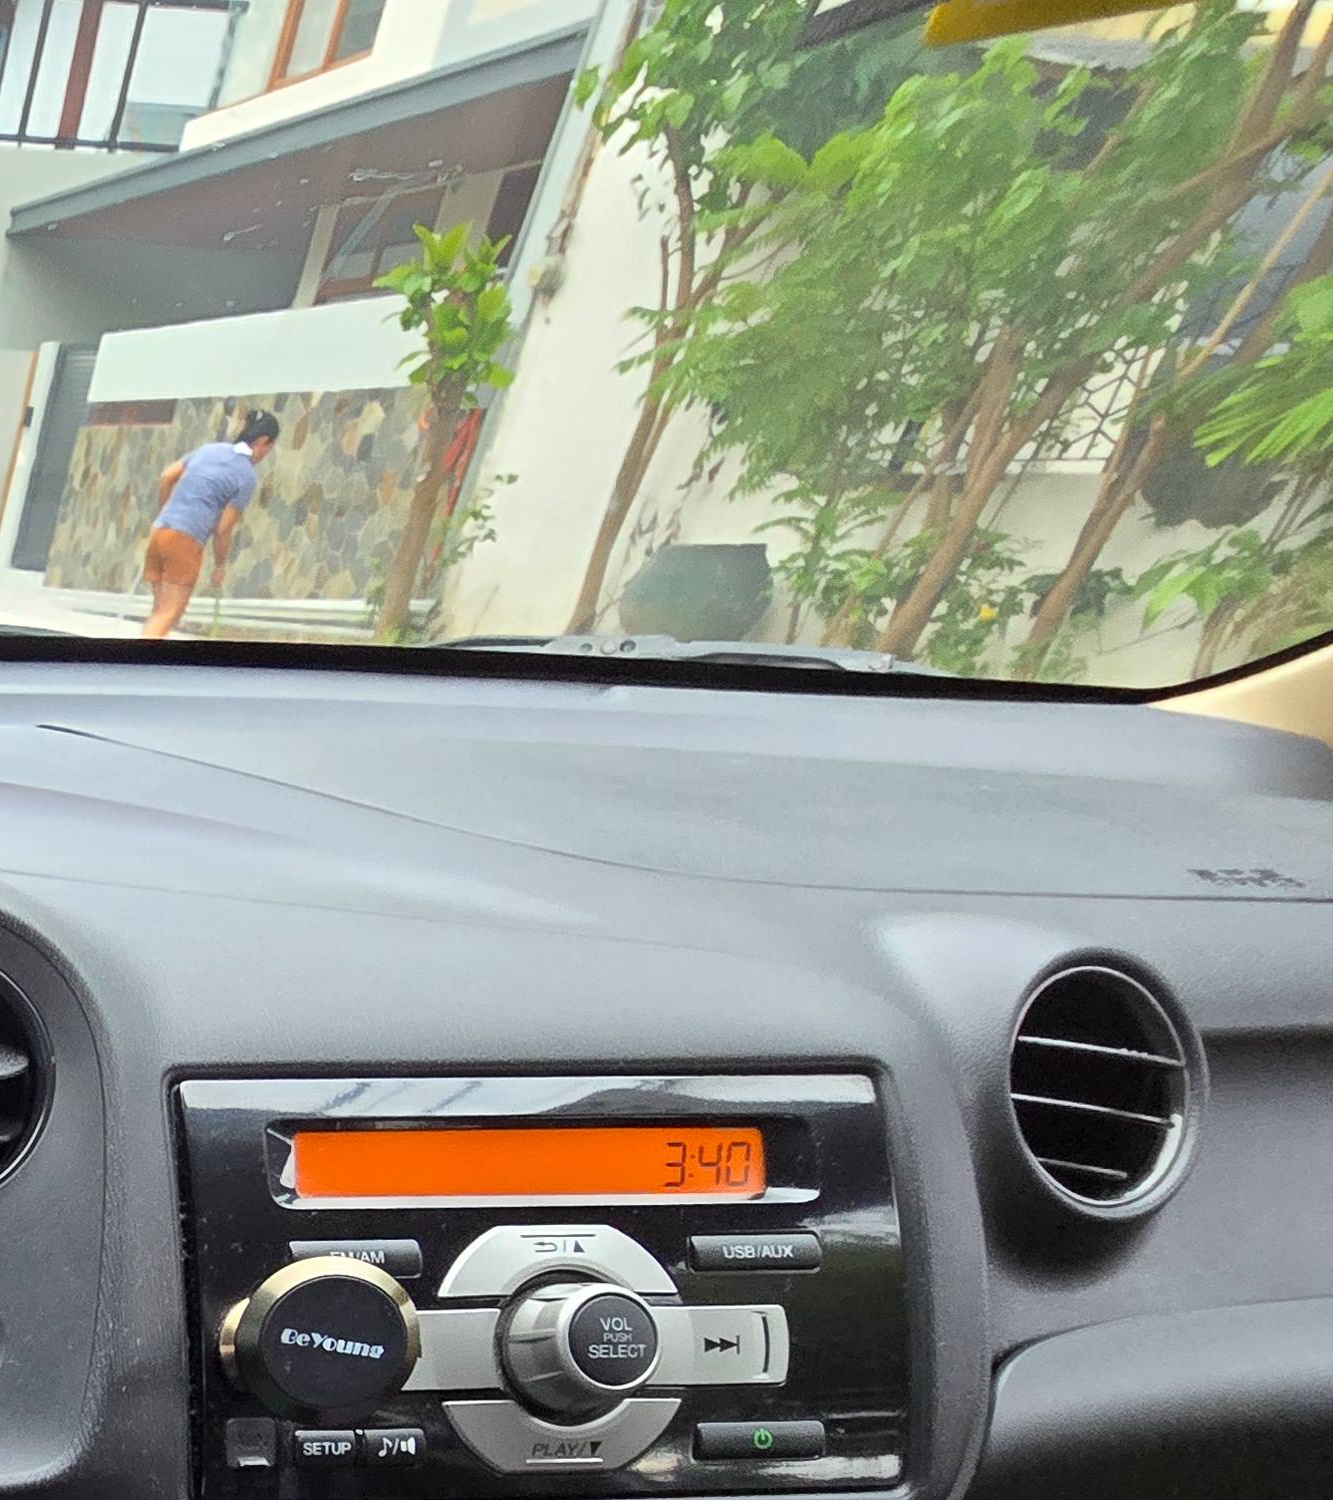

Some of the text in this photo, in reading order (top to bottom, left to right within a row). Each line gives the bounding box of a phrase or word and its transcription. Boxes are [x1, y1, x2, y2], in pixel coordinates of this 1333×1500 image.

[663, 1141, 752, 1187] 3:40
[723, 1245, 794, 1259] USB/AUX
[599, 1317, 633, 1331] VOL
[603, 1333, 632, 1342] PUSH
[588, 1344, 646, 1359] SELECT
[302, 1442, 352, 1456] SETUP
